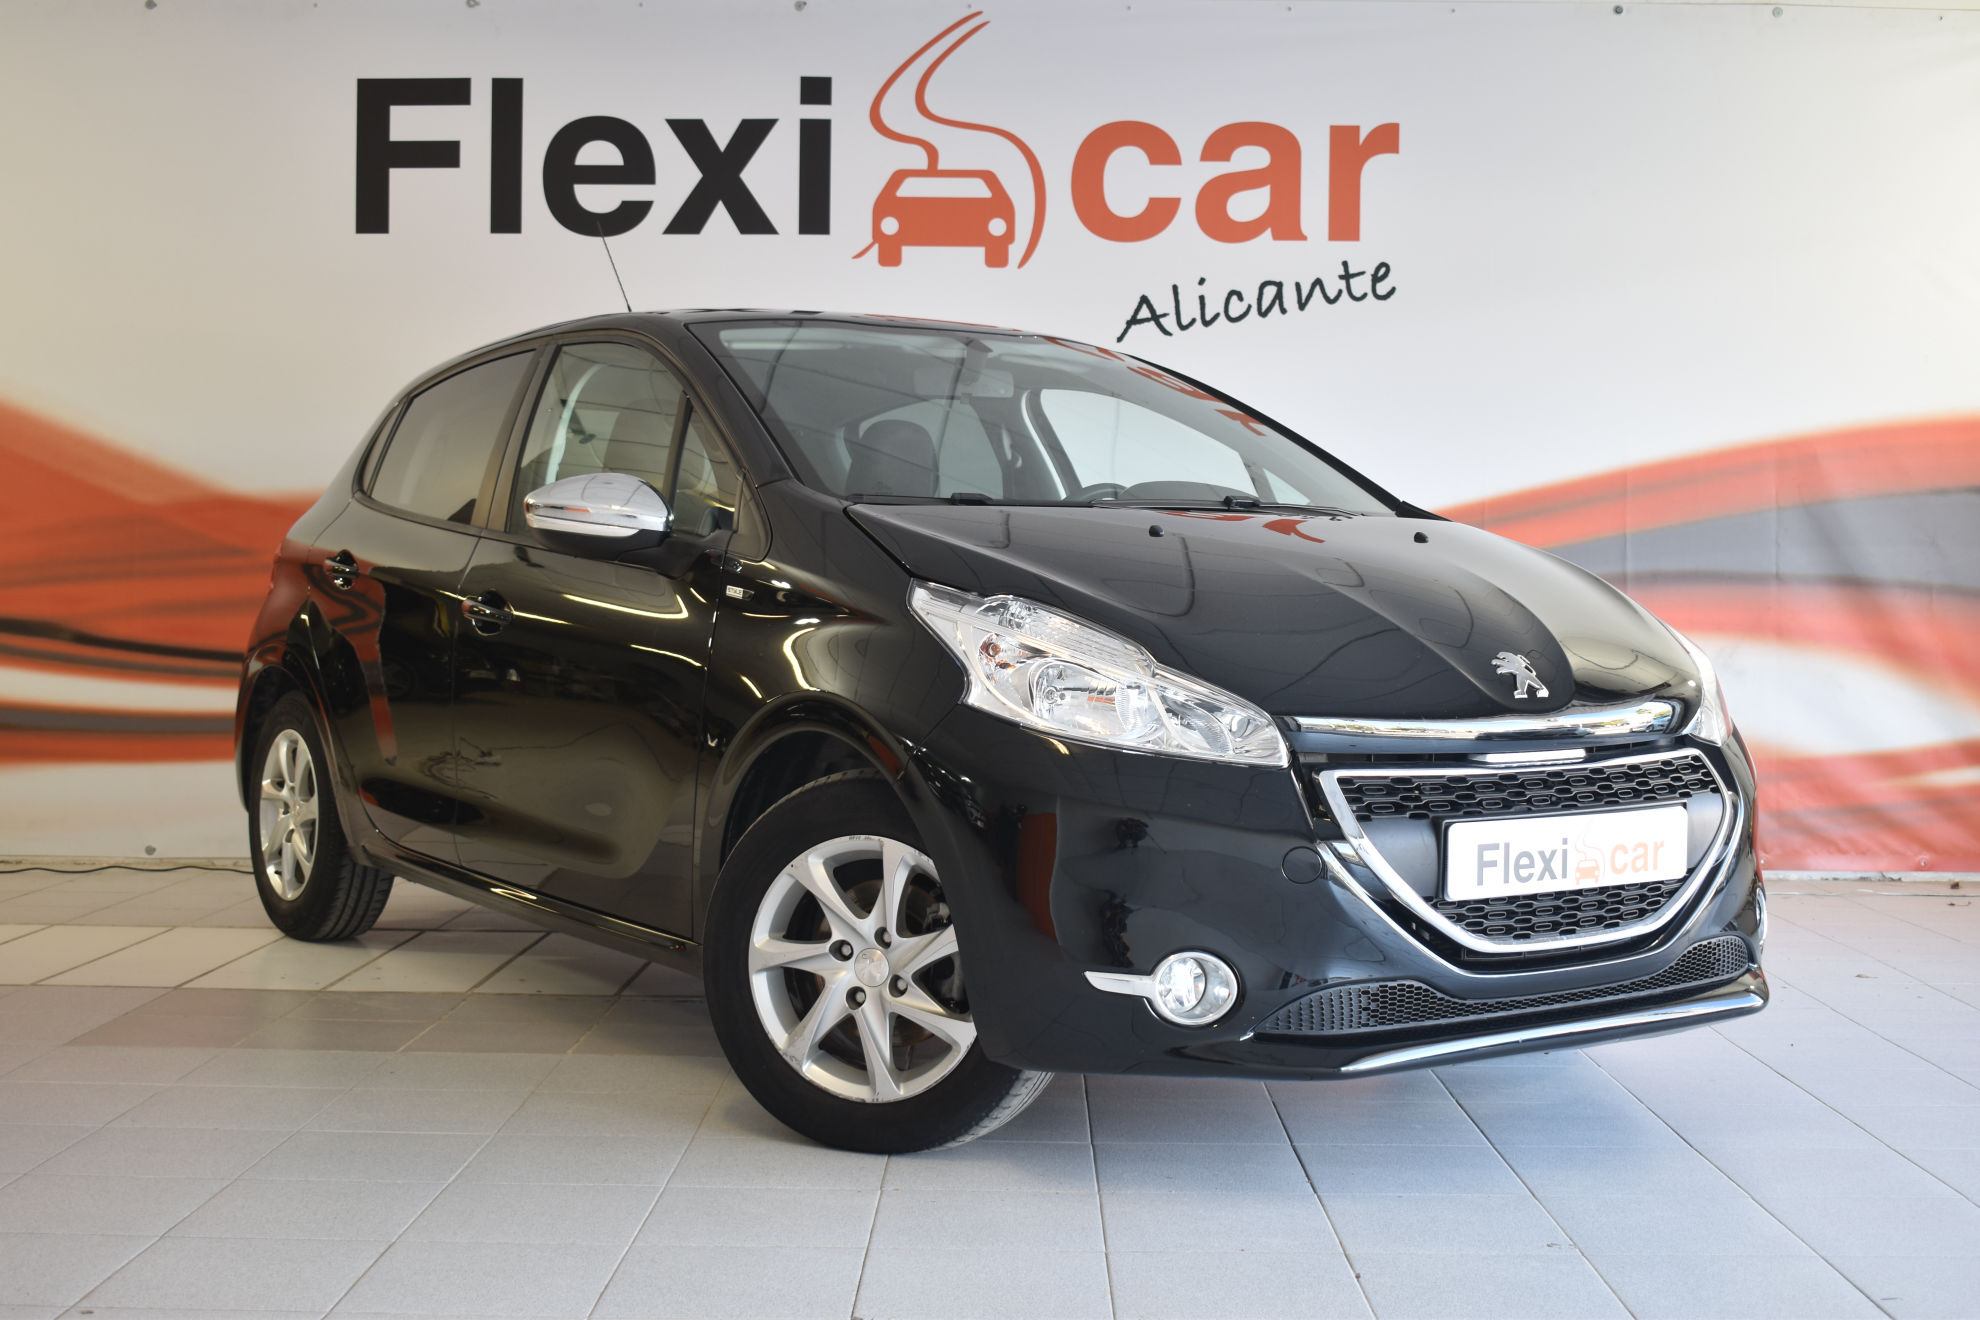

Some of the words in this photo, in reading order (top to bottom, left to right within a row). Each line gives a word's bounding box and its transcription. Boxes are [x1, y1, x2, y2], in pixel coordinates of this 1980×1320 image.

[356, 76, 832, 236] Flexi
[1071, 120, 1400, 242] car
[1117, 261, 1397, 342] Alicante
[1477, 838, 1568, 886] Flexi
[1610, 840, 1665, 875] car
